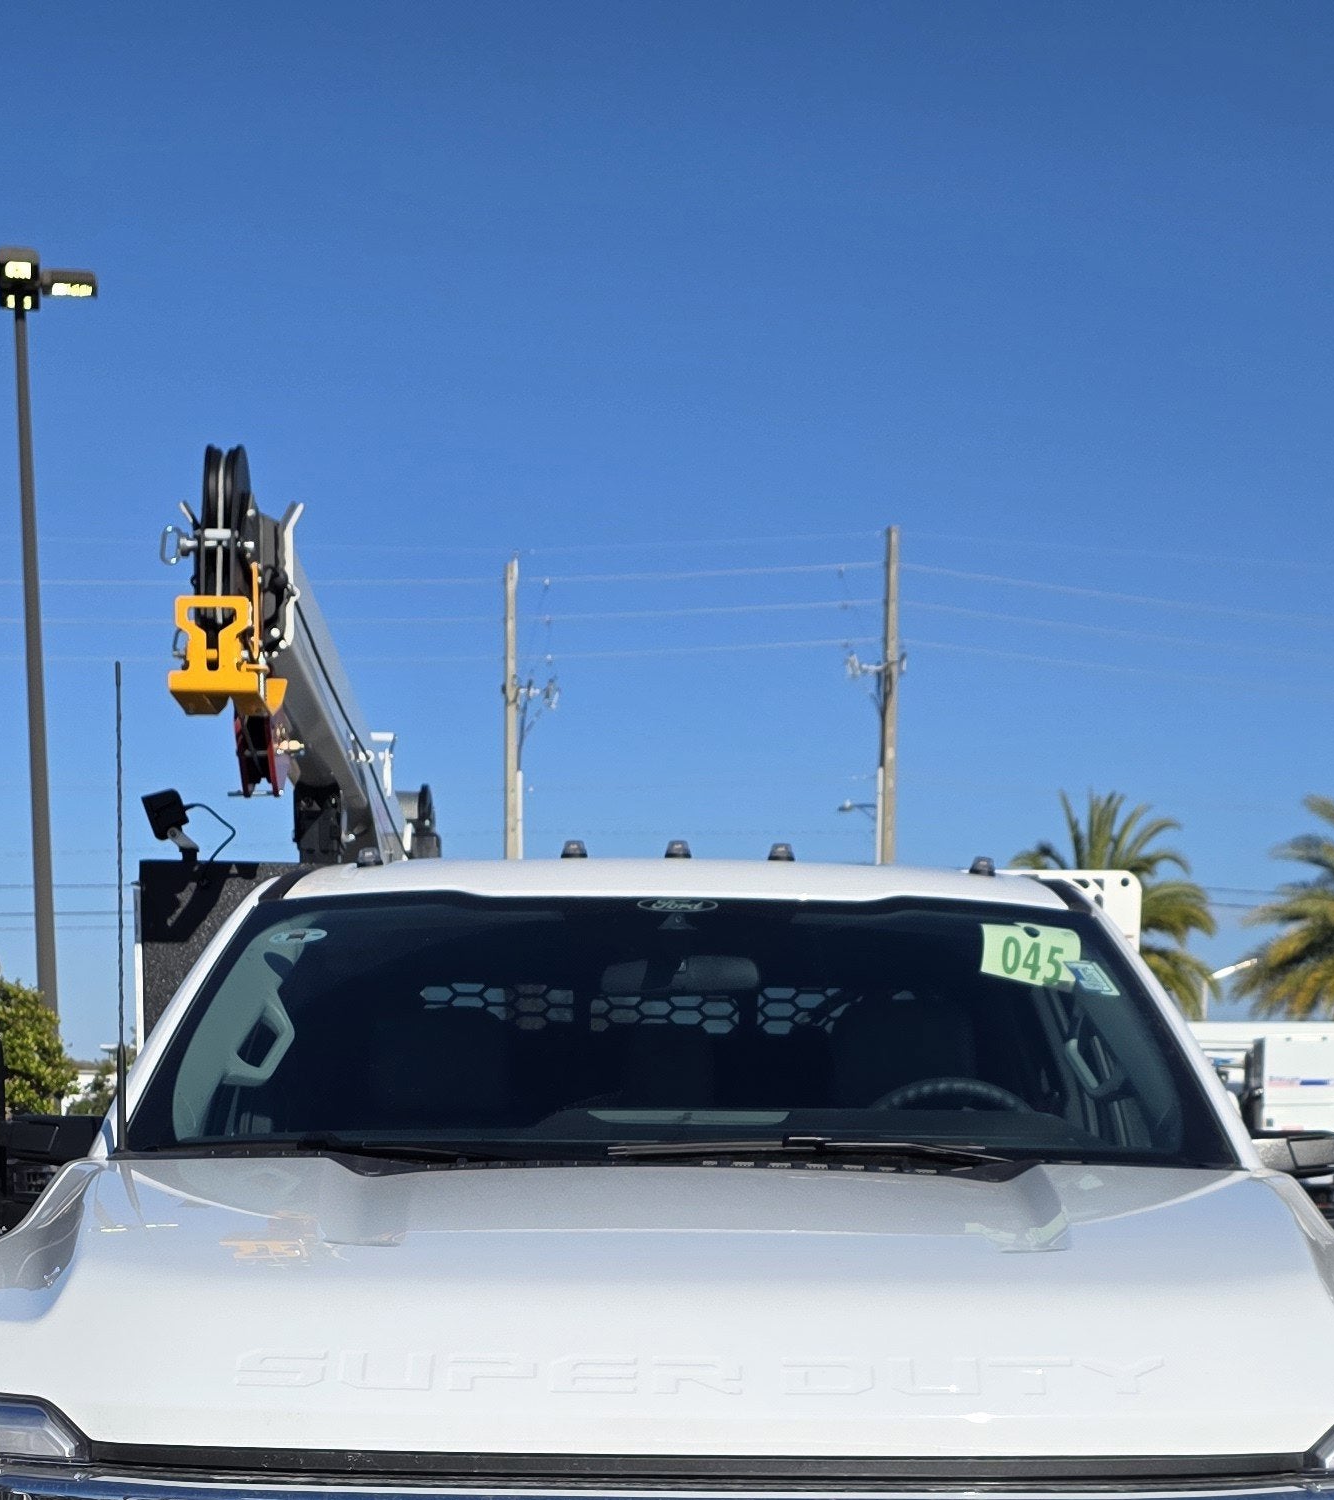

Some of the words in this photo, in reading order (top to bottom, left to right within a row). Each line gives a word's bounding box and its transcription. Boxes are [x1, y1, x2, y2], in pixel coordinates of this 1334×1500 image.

[1002, 936, 1064, 986] 045
[234, 1349, 744, 1396] SUPER
[779, 1356, 1166, 1396] DUTY
